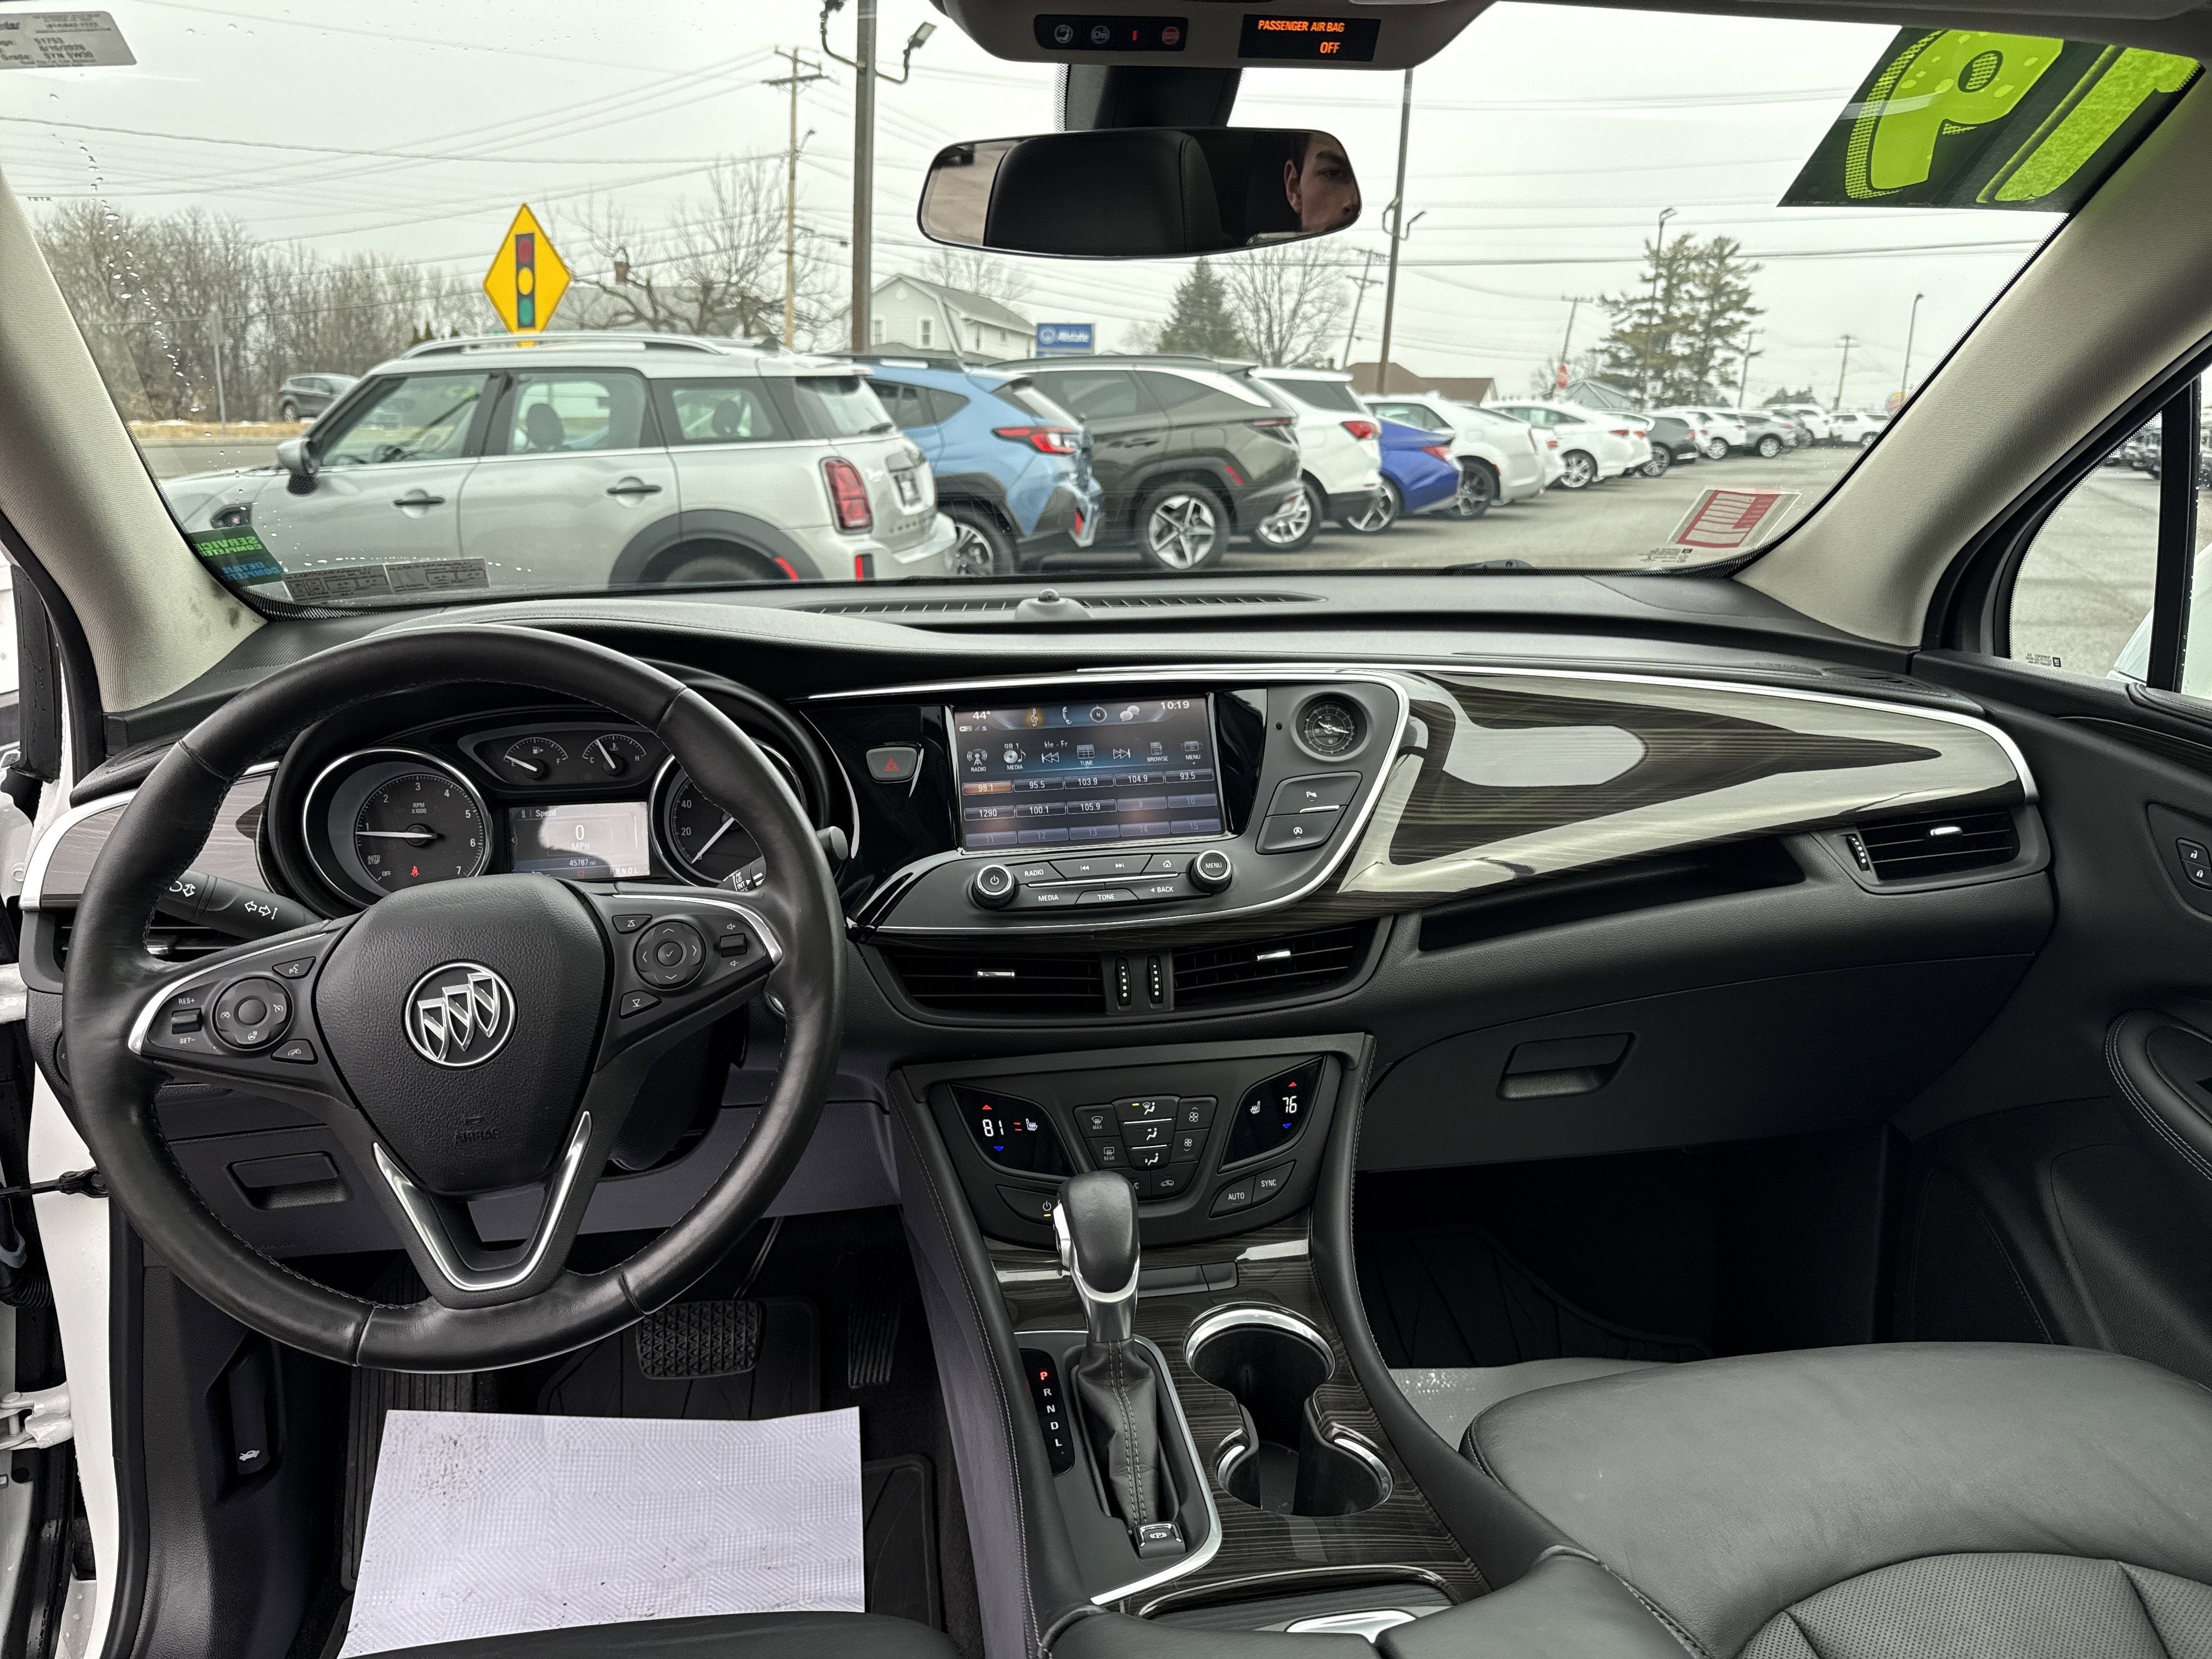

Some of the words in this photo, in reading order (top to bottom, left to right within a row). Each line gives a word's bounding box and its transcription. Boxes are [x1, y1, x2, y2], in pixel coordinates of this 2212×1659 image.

[1258, 20, 1308, 31] PASSENGER
[1310, 22, 1326, 32] AIR
[1327, 22, 1345, 32] BAG
[1320, 42, 1341, 54] OFF
[1160, 701, 1190, 710] 10:19
[415, 782, 421, 791] 3
[978, 784, 994, 792] 98.1
[1029, 781, 1045, 789] 95.5
[1078, 778, 1098, 786] 103.9
[1128, 775, 1148, 783] 104.9
[1180, 772, 1195, 780] 93.5
[444, 789, 450, 798] 4
[383, 794, 389, 803] 2
[681, 799, 692, 808] 40
[465, 809, 471, 819] 5
[535, 809, 556, 818] Speed
[979, 809, 997, 817] 1290
[1030, 806, 1049, 814] 100.1
[1080, 803, 1101, 811] 105.9
[365, 822, 370, 831] 1
[1088, 828, 1097, 837] 13
[1139, 825, 1148, 833] 14
[575, 824, 585, 840] 0
[681, 827, 692, 836] 20
[470, 838, 476, 847] 6
[572, 842, 590, 851] MPH
[456, 866, 461, 875] 7
[1024, 869, 1043, 877] RADIO
[737, 881, 745, 890] INT
[1038, 894, 1059, 902] MEDIA
[1282, 1095, 1297, 1114] 76
[983, 1119, 1004, 1136] 81
[1261, 1179, 1277, 1187] SYNC
[1228, 1192, 1245, 1200] AUTO
[1040, 1372, 1048, 1380] P
[1043, 1388, 1052, 1396] R
[1046, 1404, 1056, 1413] N
[1050, 1421, 1059, 1430] D
[1055, 1438, 1063, 1447] L
